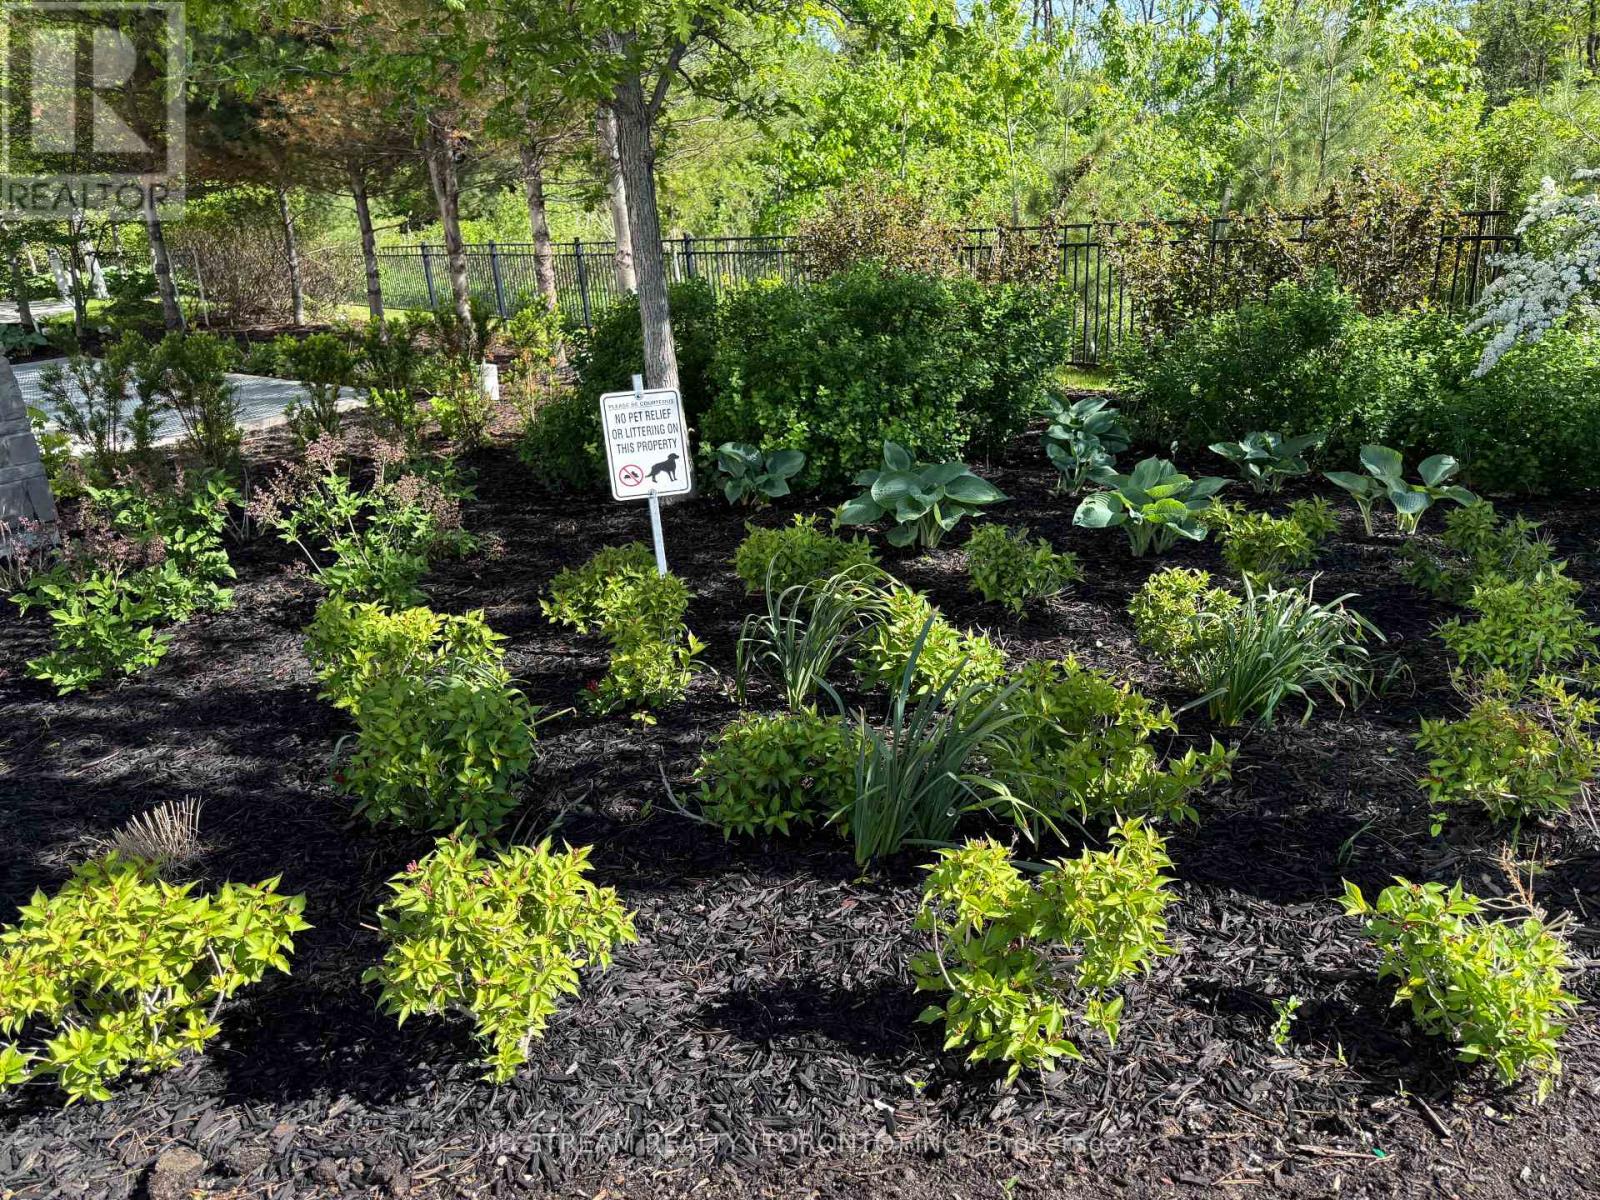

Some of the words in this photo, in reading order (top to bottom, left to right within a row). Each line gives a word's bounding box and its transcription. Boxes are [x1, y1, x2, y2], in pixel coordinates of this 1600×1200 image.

[614, 413, 627, 424] NO
[628, 411, 643, 423] PET
[644, 408, 671, 421] RELIEF
[611, 428, 624, 440] OR
[624, 423, 666, 439] LITTERING
[666, 422, 679, 434] ON
[616, 442, 635, 454] THIS
[636, 437, 677, 453] PROPERTY
